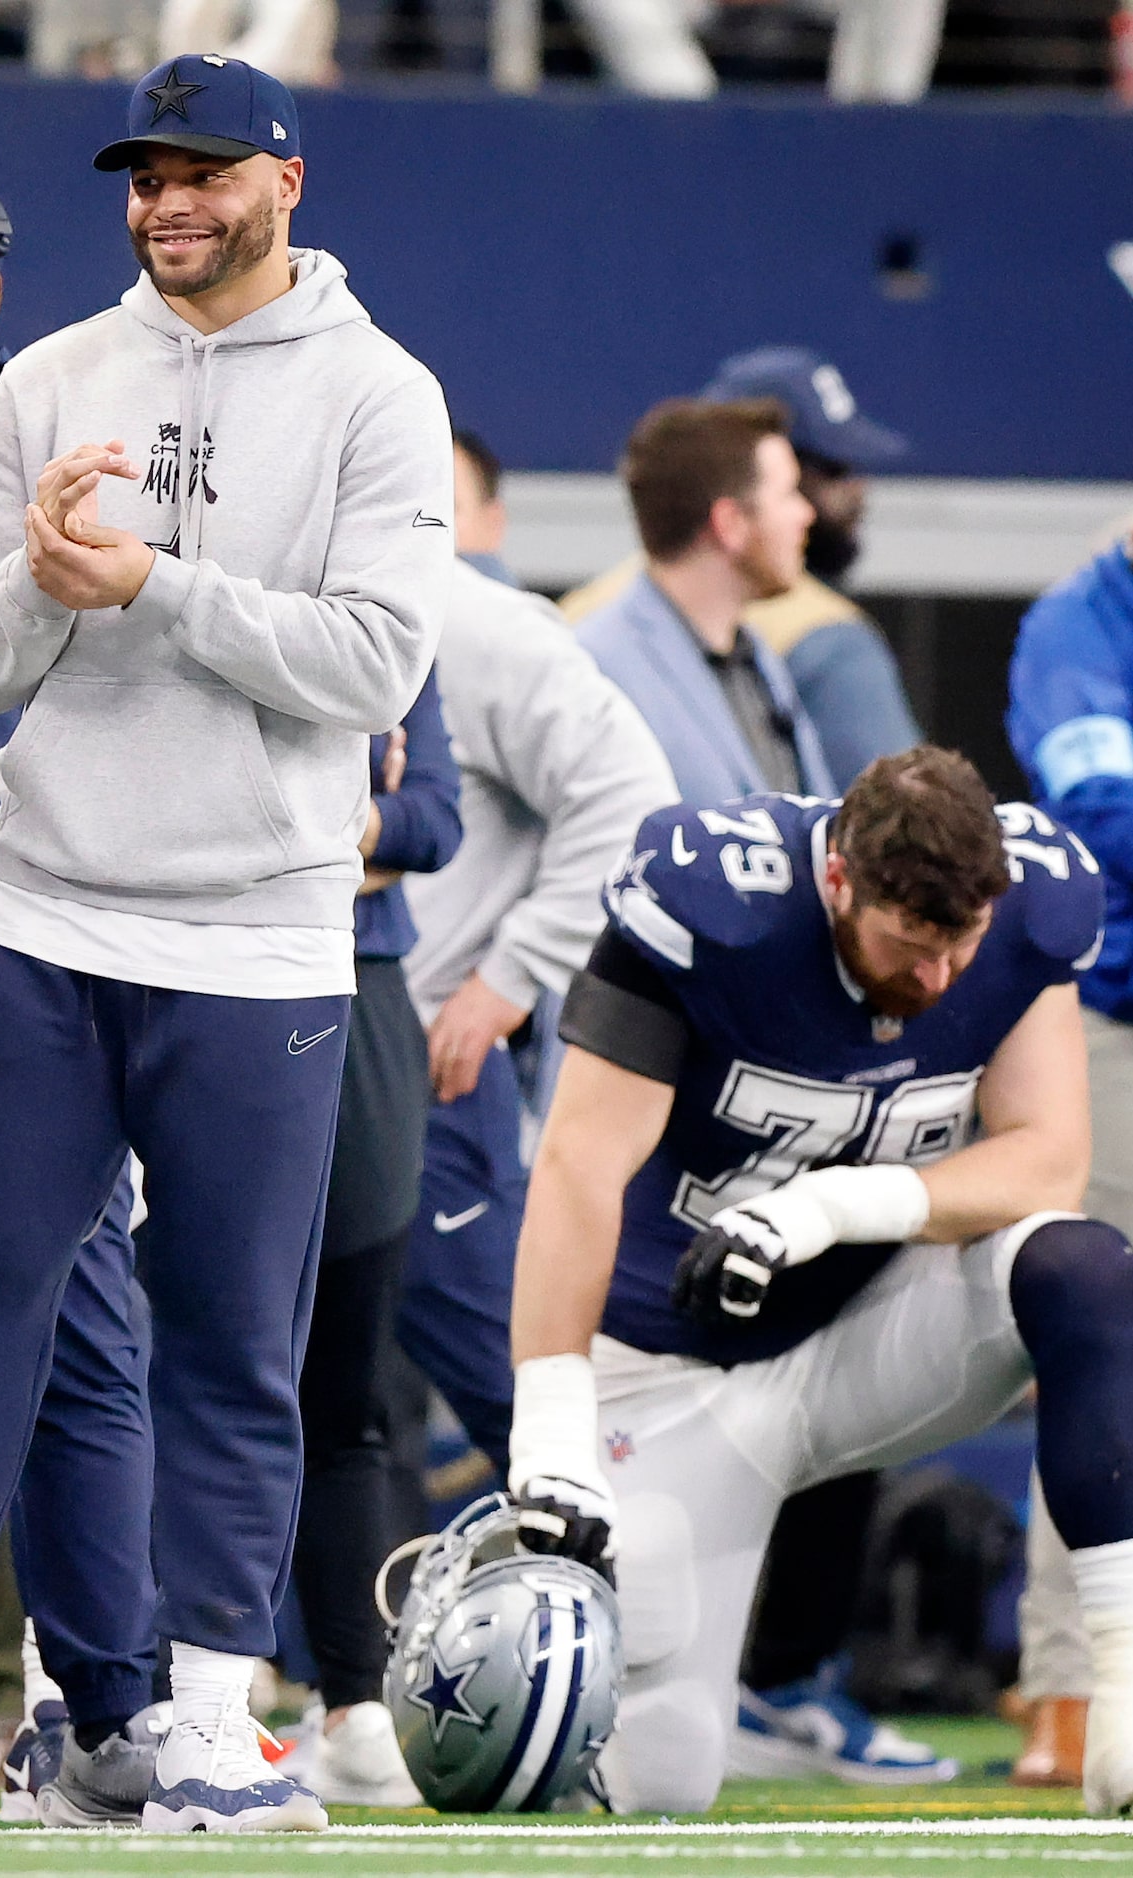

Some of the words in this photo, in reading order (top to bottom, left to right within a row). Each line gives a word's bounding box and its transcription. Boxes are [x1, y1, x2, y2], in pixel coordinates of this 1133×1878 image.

[150, 444, 216, 460] CHNE
[697, 807, 794, 894] 79
[669, 1059, 985, 1233] 79
